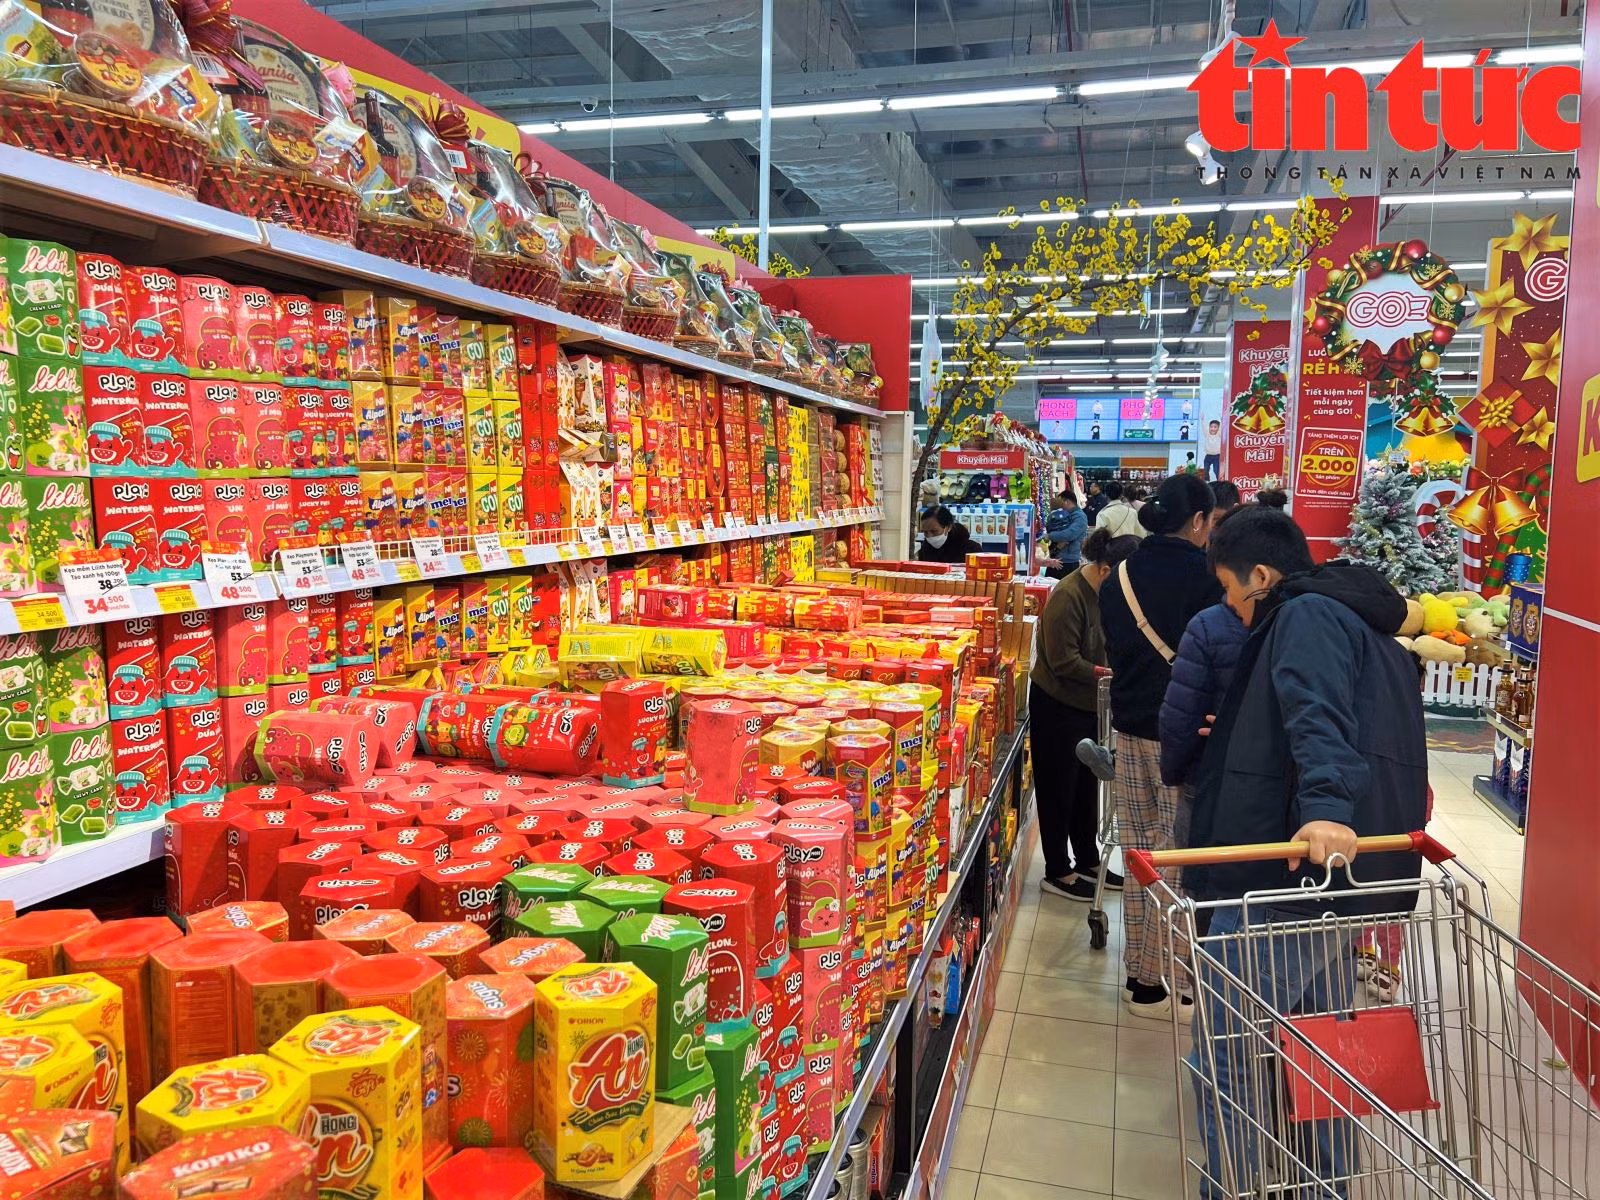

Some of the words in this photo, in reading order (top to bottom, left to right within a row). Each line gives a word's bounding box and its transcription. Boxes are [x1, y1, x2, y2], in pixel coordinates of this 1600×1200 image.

[1303, 358, 1325, 374] RẺ
[1313, 397, 1329, 405] mỗi
[1332, 398, 1353, 406] ngày
[1235, 432, 1284, 448] Khuyến
[1245, 449, 1274, 462] Mãi!
[1319, 447, 1344, 456] TRÊN
[957, 454, 988, 465] Khuyến
[990, 455, 1008, 464] Mãi!
[1303, 458, 1354, 472] 2.000
[302, 566, 311, 575] 53
[352, 569, 365, 580] 48
[423, 562, 434, 573] 24
[231, 572, 242, 581] 53
[296, 577, 310, 588] 48
[98, 580, 113, 590] 38
[221, 586, 239, 599] 48
[85, 598, 108, 614] 34
[784, 845, 810, 862] play
[459, 888, 492, 908] play
[225, 905, 253, 929] sugus
[412, 922, 462, 951] sugus
[507, 941, 558, 968] sugus
[467, 979, 507, 1011] sugus
[568, 1033, 649, 1108] An
[170, 1140, 272, 1178] KOPIKO
